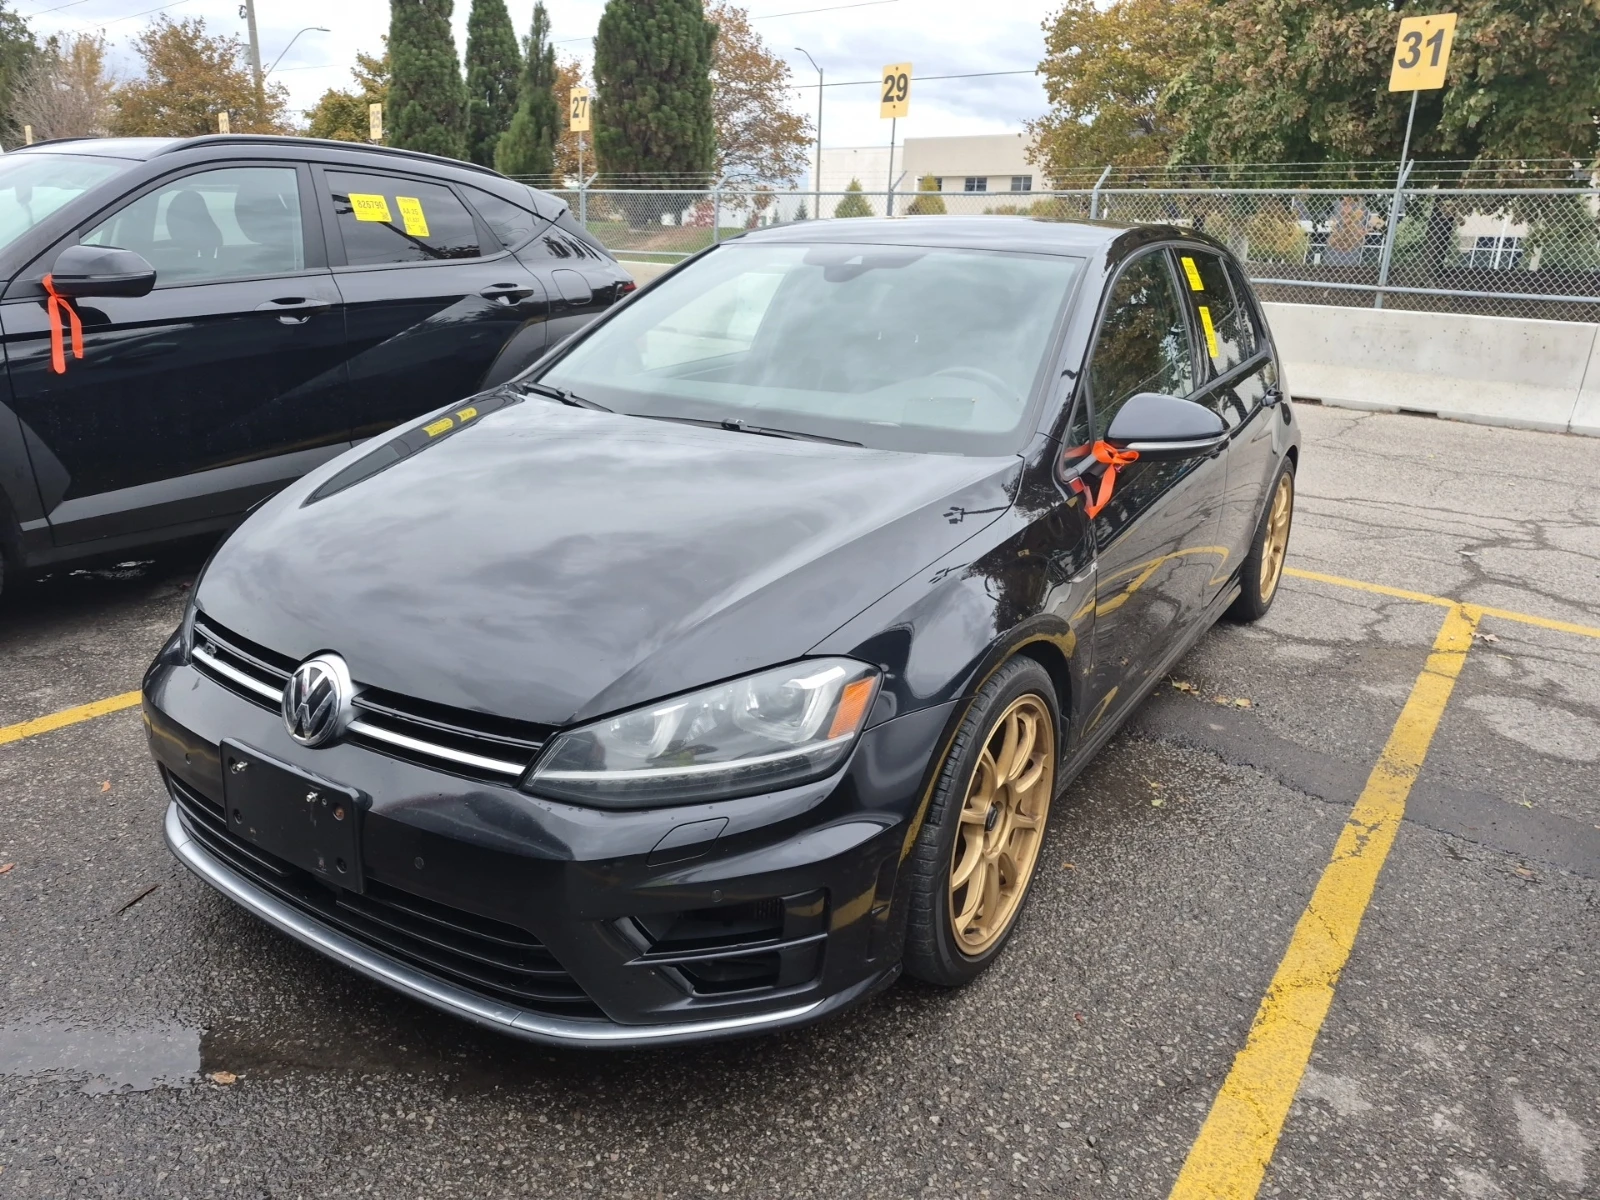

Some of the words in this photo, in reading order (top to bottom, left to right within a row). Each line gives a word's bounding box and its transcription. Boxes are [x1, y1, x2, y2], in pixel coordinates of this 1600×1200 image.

[1398, 28, 1445, 69] 31
[882, 73, 908, 103] 29
[370, 110, 381, 129] 25
[572, 95, 588, 118] 27
